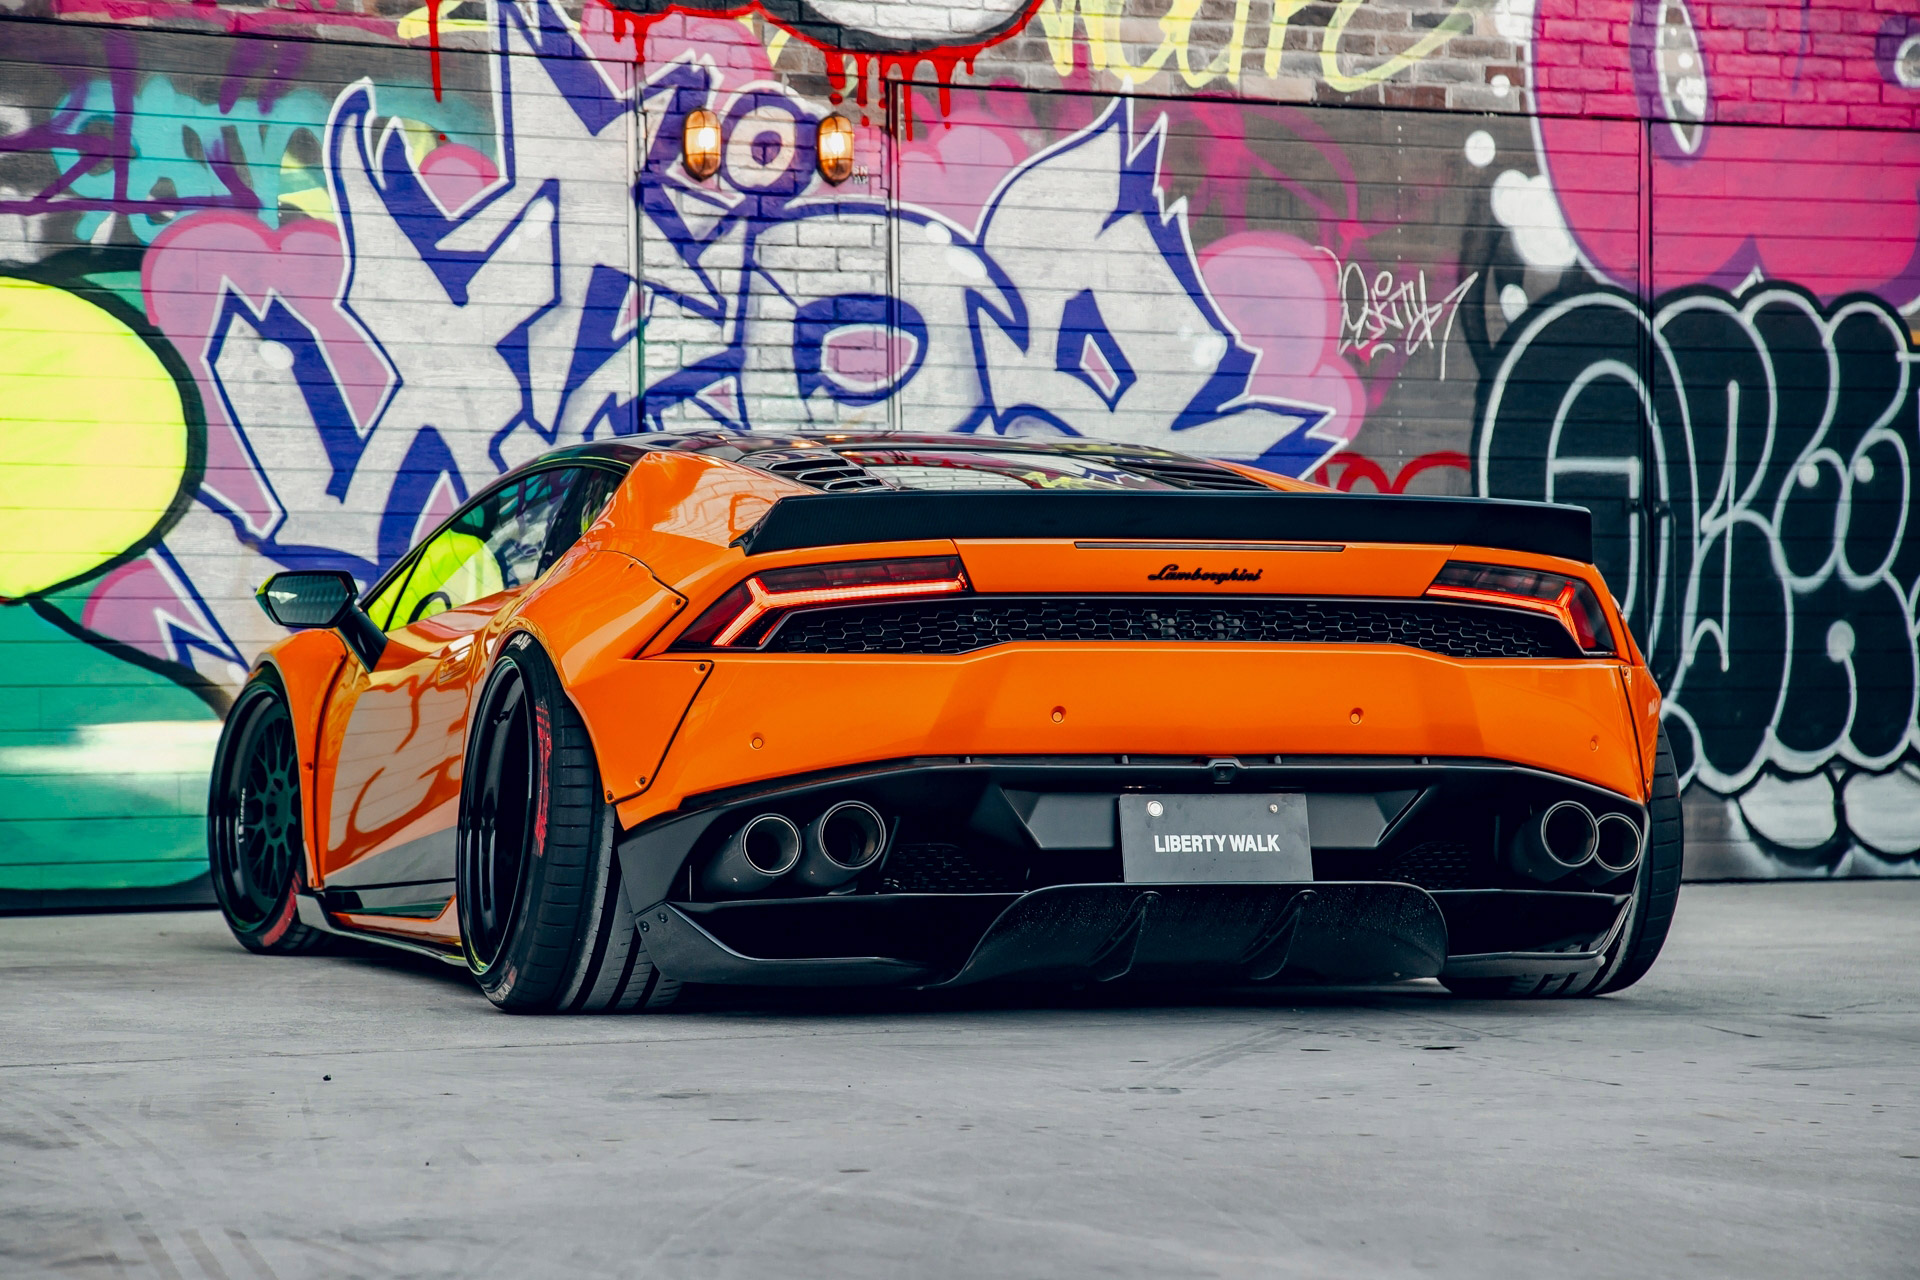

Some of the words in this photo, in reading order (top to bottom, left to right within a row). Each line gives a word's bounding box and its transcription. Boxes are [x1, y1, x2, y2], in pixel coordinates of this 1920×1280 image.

[1148, 563, 1263, 585] Lamborghini
[1154, 834, 1226, 853] LIBERTY
[1229, 834, 1281, 852] WALK
